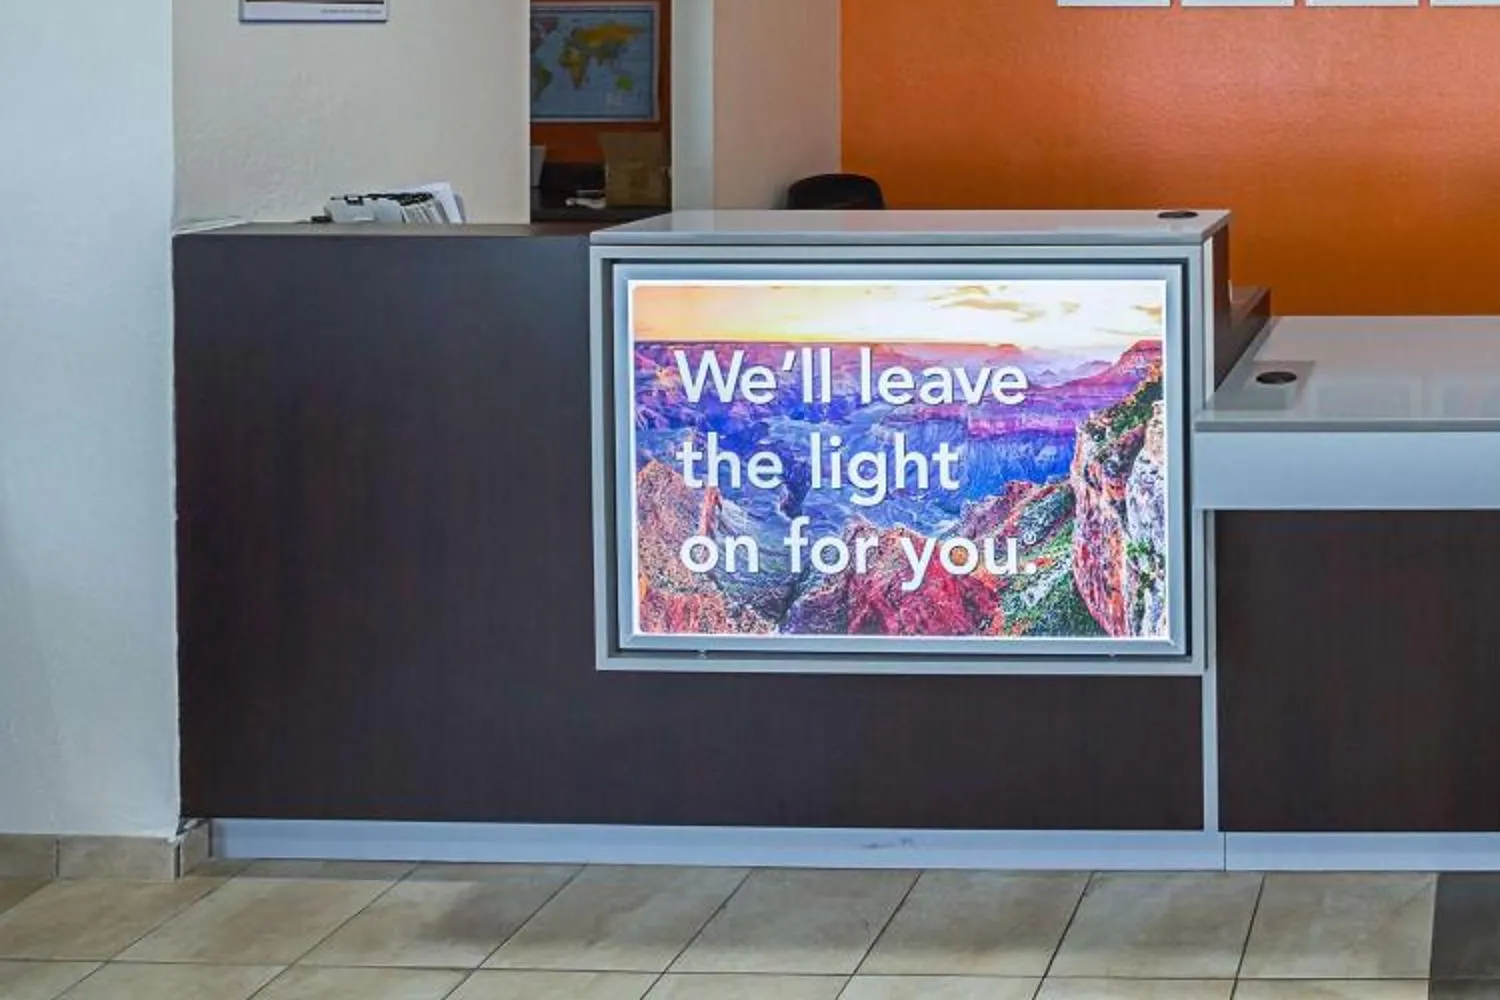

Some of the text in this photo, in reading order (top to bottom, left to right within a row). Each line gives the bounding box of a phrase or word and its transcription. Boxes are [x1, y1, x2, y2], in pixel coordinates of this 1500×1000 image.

[673, 346, 1030, 405] We'll leave
[675, 431, 961, 506] the light
[679, 532, 760, 574] on
[783, 517, 880, 574] for
